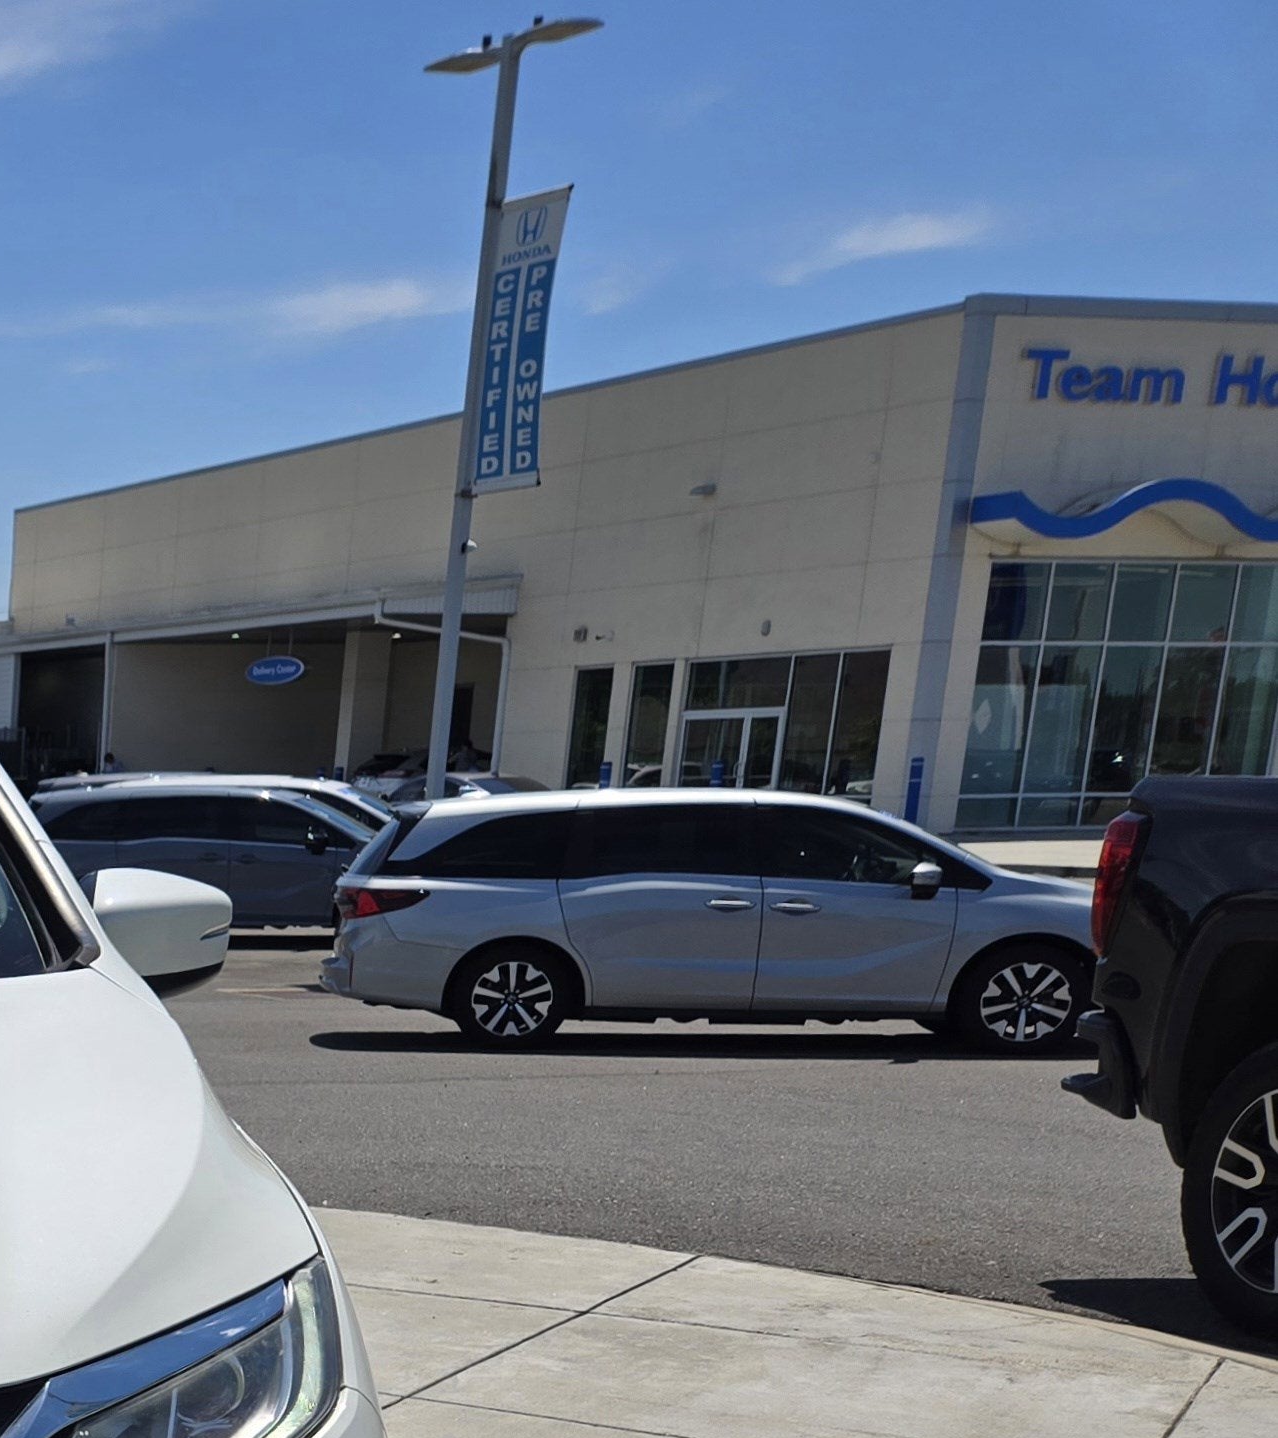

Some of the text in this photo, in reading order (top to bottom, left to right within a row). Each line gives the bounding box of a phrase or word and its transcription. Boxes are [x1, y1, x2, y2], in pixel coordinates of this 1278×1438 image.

[500, 244, 552, 267] HONDA
[479, 273, 516, 476] CERTIFIED
[515, 265, 548, 470] PRE OWNED
[1025, 348, 1186, 405] Team
